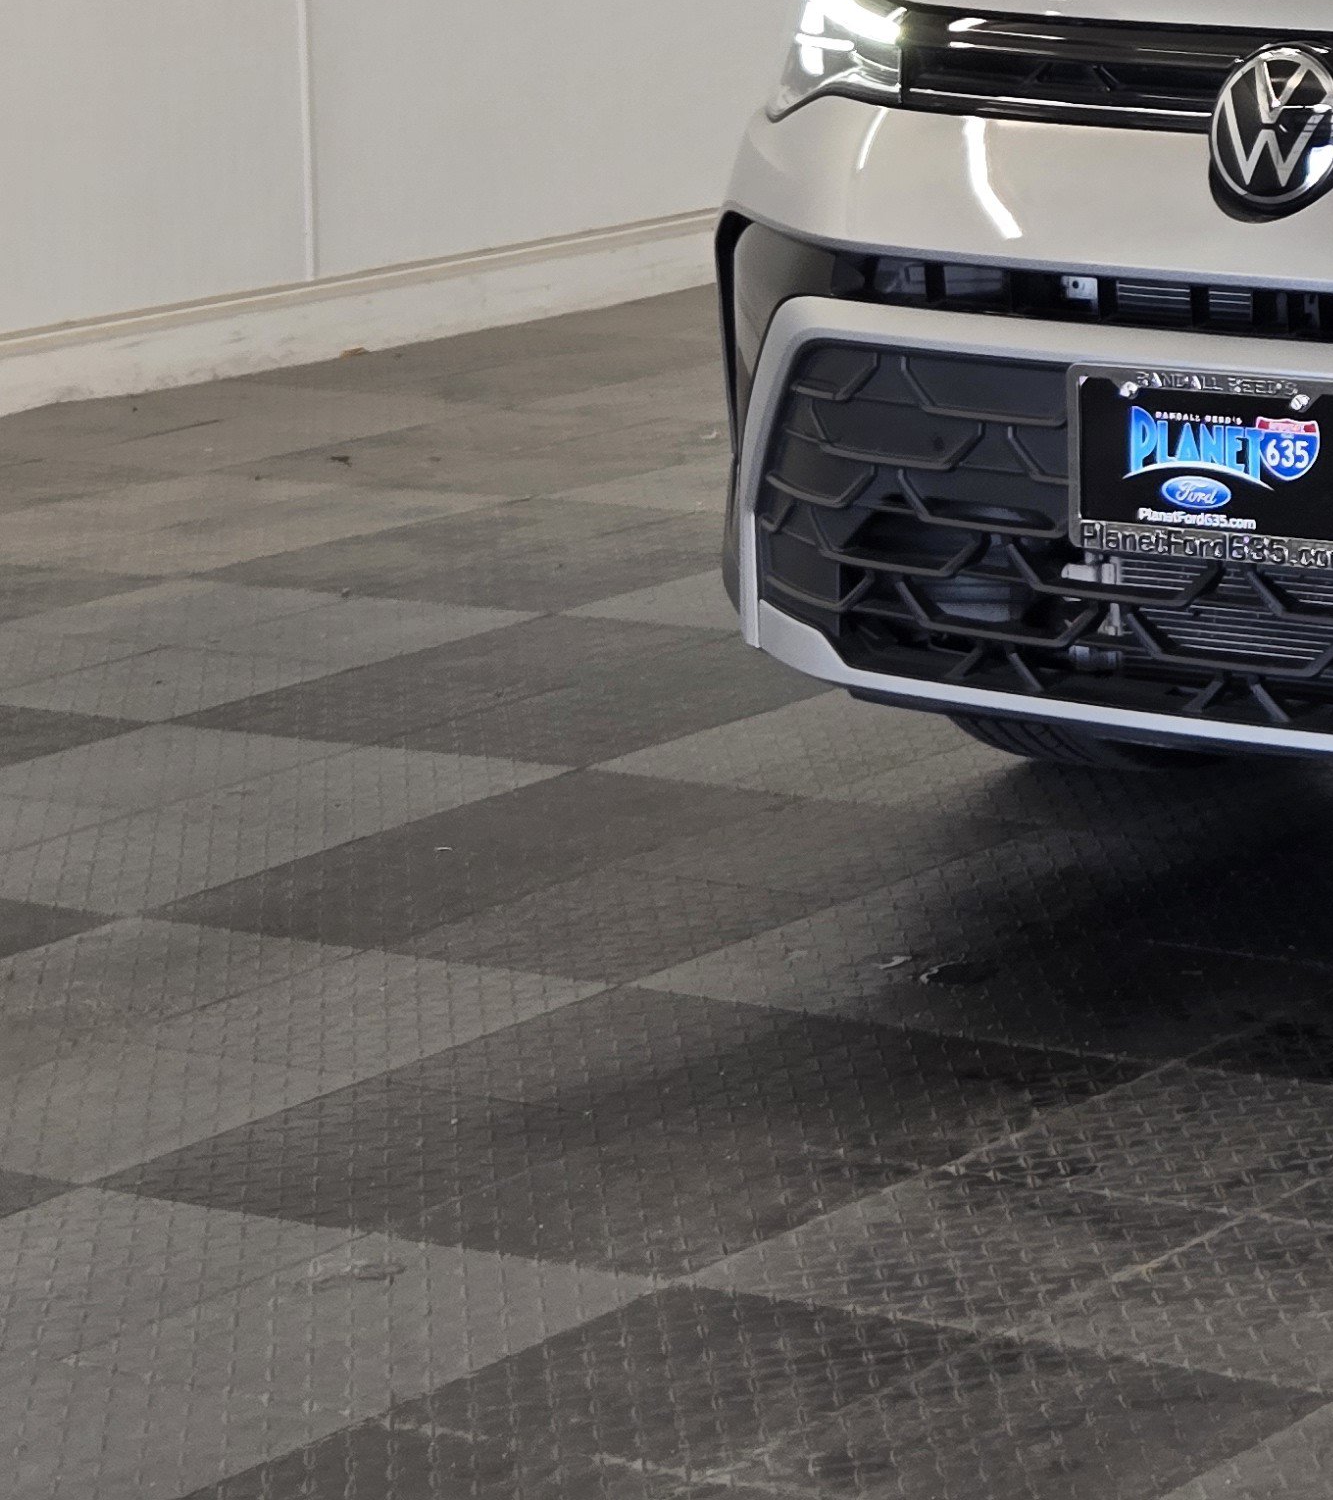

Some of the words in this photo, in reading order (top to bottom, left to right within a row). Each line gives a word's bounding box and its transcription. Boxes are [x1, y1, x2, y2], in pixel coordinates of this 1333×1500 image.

[1136, 371, 1224, 391] RANDALL
[1227, 377, 1299, 396] REED'S
[1130, 405, 1264, 482] PLANET
[1265, 438, 1309, 470] 635
[1174, 479, 1218, 506] Ford
[1137, 507, 1257, 531] PlanetFord635.com
